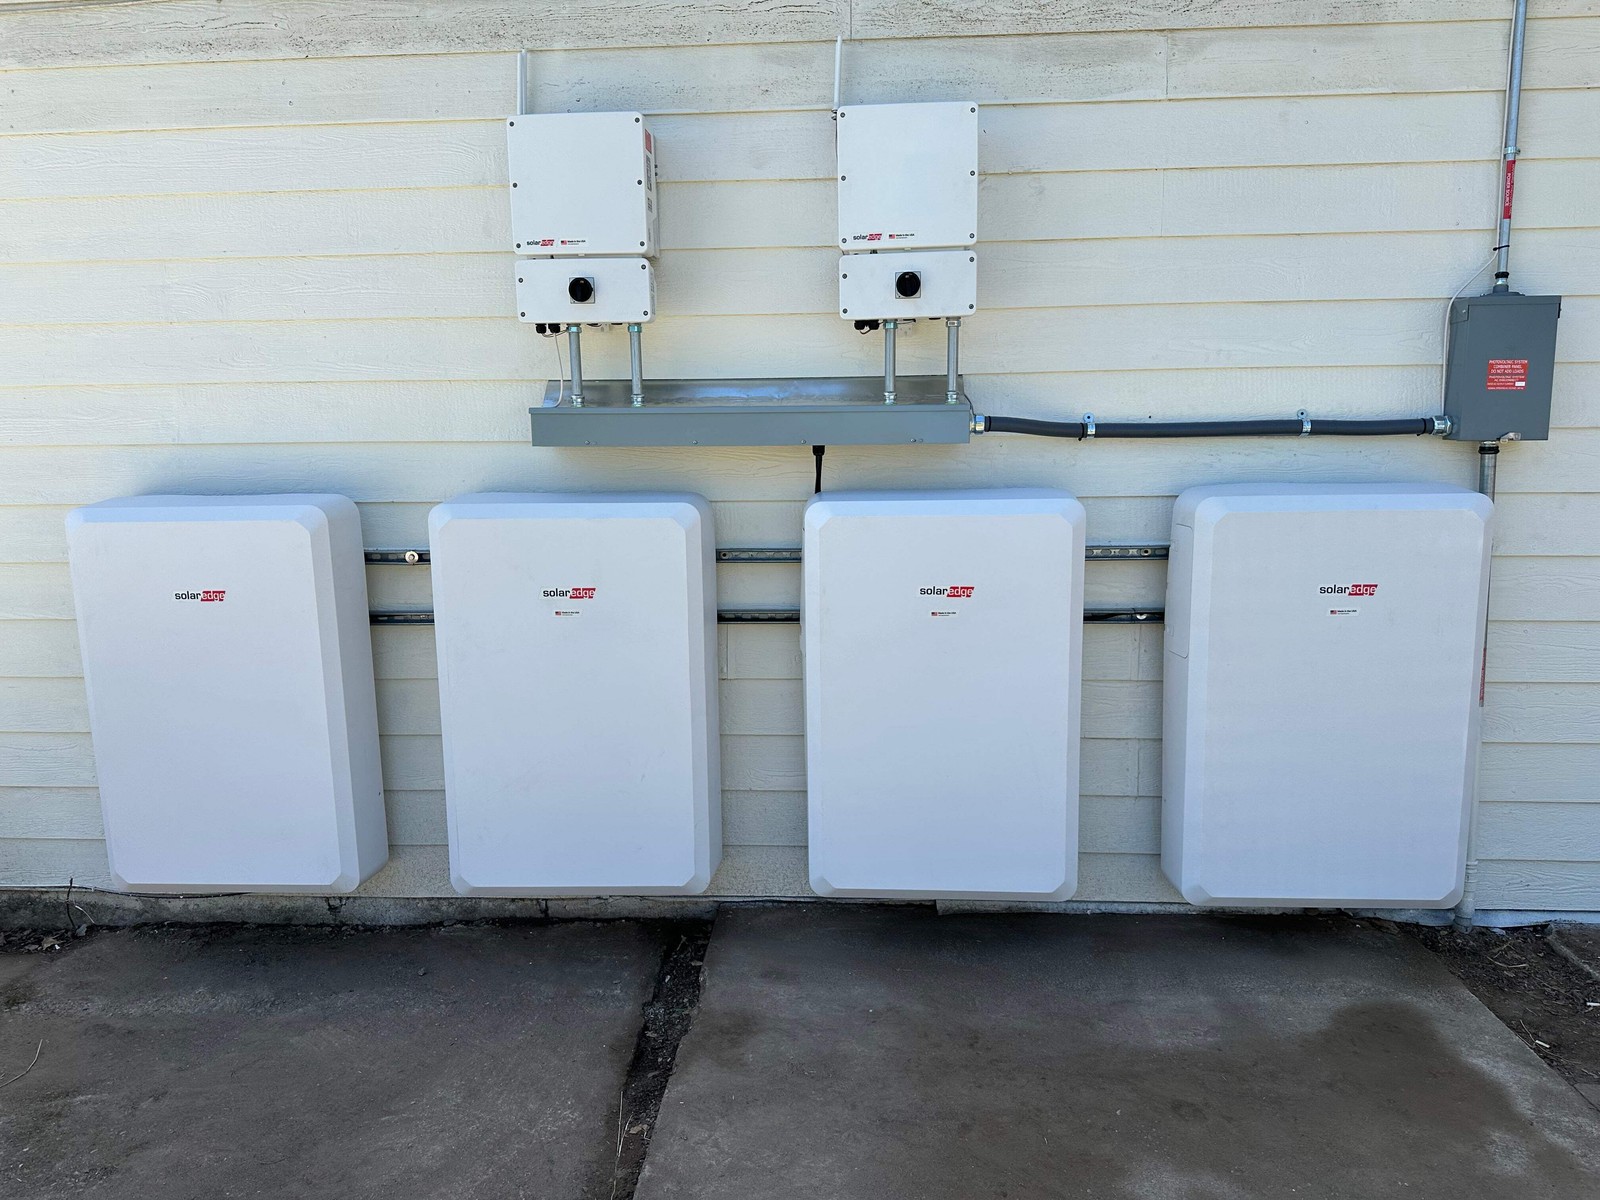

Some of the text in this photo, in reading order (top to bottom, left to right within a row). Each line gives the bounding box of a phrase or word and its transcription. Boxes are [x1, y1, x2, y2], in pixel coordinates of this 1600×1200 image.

[175, 590, 225, 601] solaredge
[543, 588, 596, 599] solaredge
[920, 586, 974, 597] solaredge
[1320, 584, 1378, 596] solaredge
